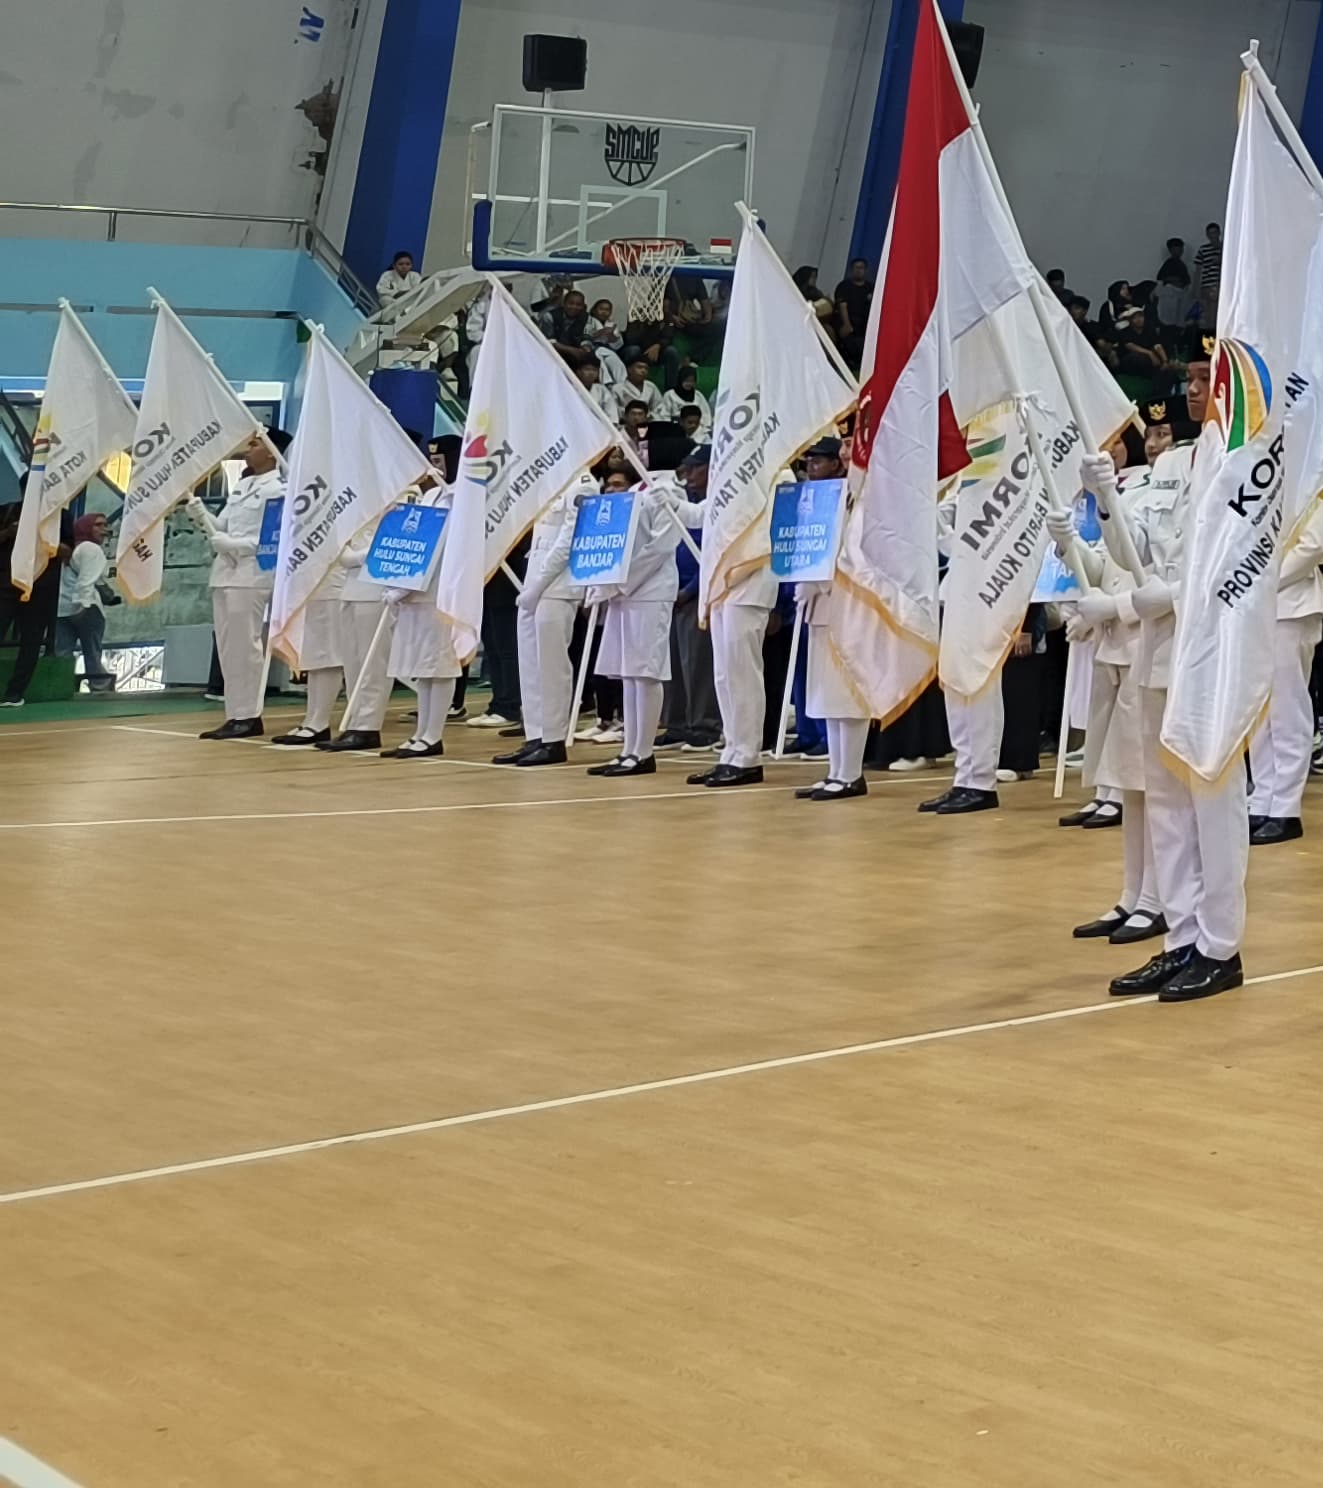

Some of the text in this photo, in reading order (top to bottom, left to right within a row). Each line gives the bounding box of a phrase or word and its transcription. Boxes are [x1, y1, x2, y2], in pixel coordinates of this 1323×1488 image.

[605, 123, 660, 161] SMCUP
[778, 524, 826, 539] KABUPATEN
[380, 537, 428, 553] KABUPATEN
[573, 532, 626, 550] KABUPATEN
[773, 539, 829, 554] HULU SUNGAI
[373, 548, 425, 566] HULU SUNGAI
[576, 552, 614, 568] BANJAR
[784, 555, 812, 568] UTARA
[379, 561, 410, 576] TENGAH
[1217, 534, 1275, 609] PROVINSI
